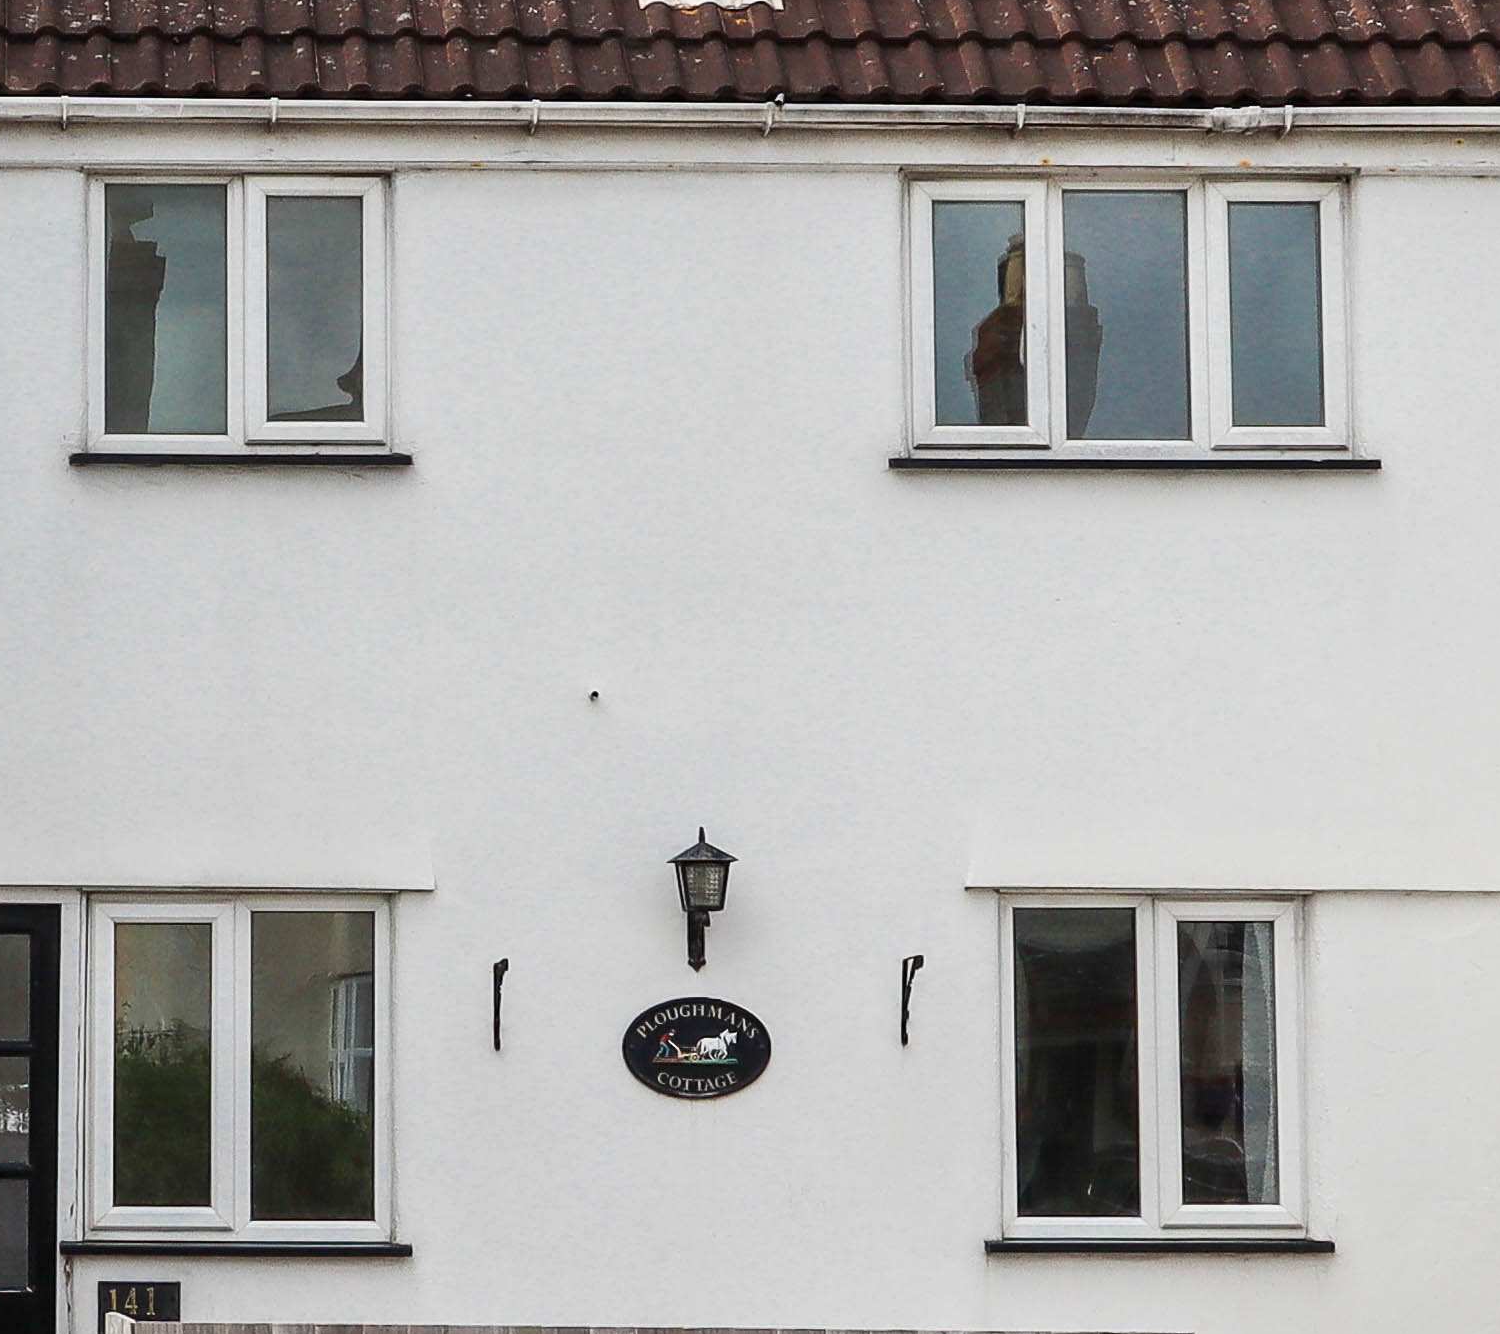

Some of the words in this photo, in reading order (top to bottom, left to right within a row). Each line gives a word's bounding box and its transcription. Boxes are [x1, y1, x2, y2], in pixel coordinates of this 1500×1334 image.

[636, 1004, 760, 1039] PLOUGHMANS
[657, 1071, 738, 1092] COTTAGE
[108, 1286, 156, 1316] 141
